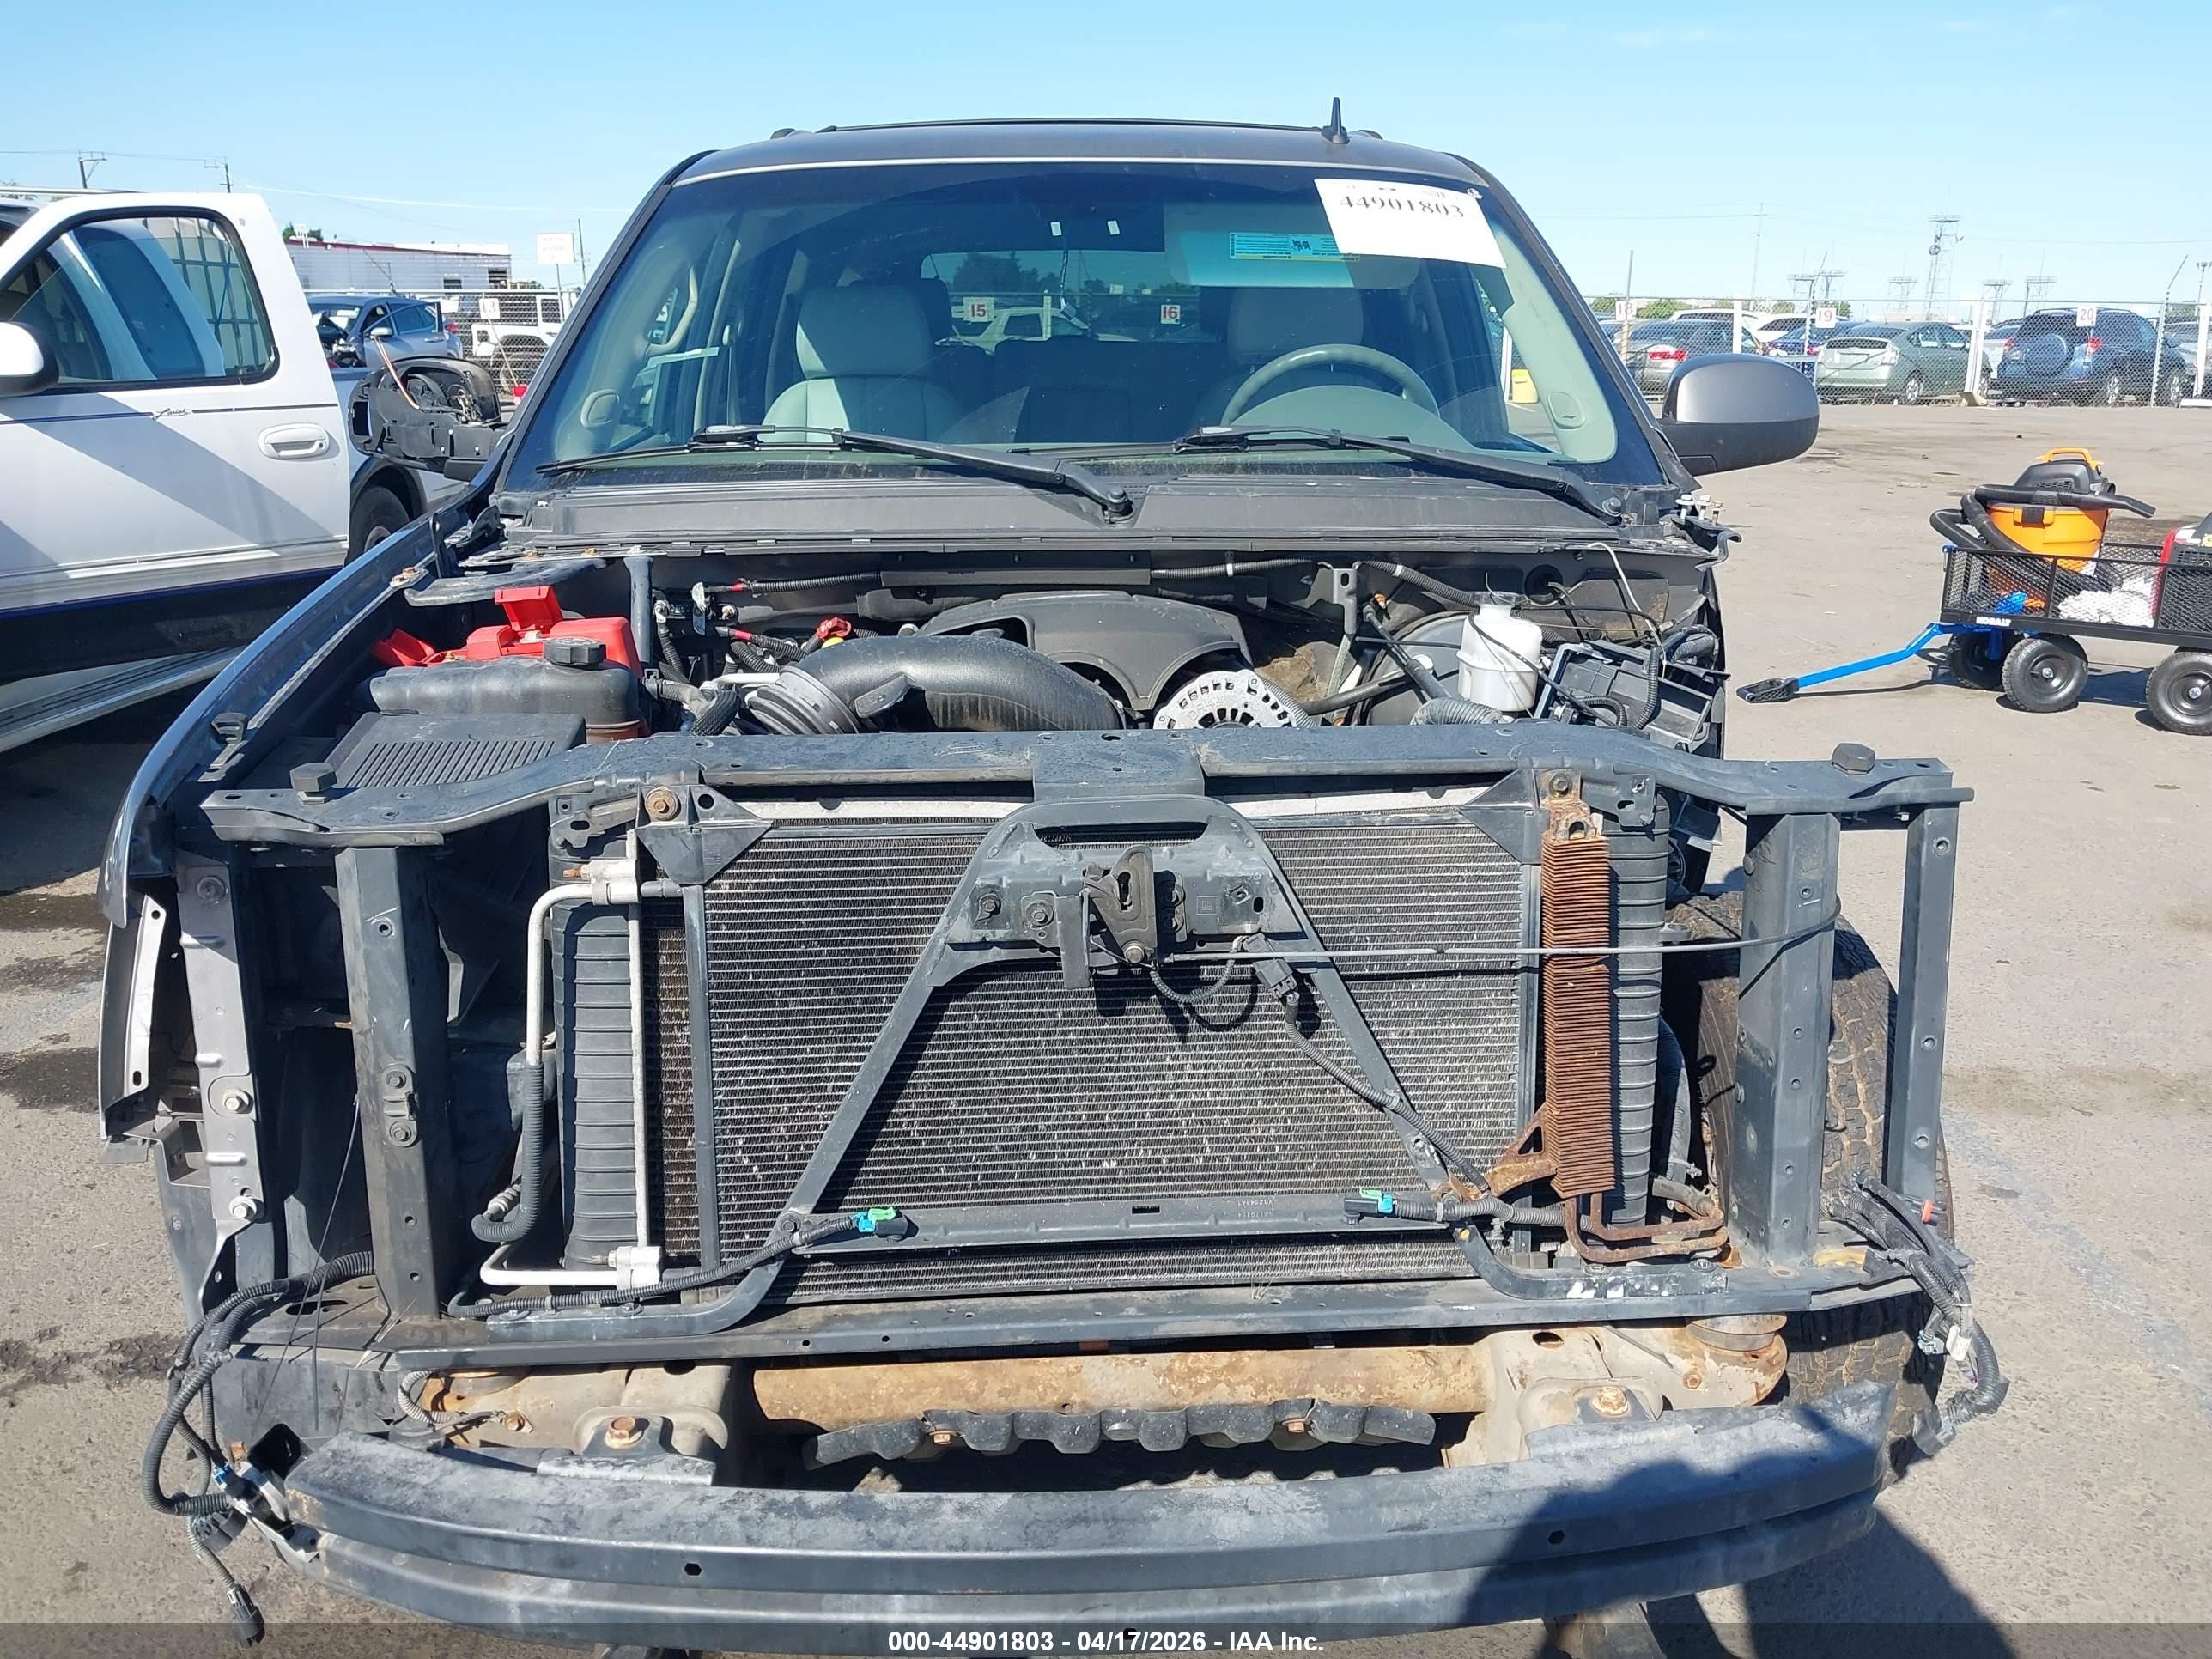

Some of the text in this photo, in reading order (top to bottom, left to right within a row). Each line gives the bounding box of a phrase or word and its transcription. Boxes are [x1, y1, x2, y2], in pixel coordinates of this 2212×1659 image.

[1340, 195, 1465, 218] 44901803
[970, 303, 986, 317] 15
[1163, 305, 1177, 319] 16
[1818, 309, 1833, 323] 19
[2079, 308, 2094, 321] 20
